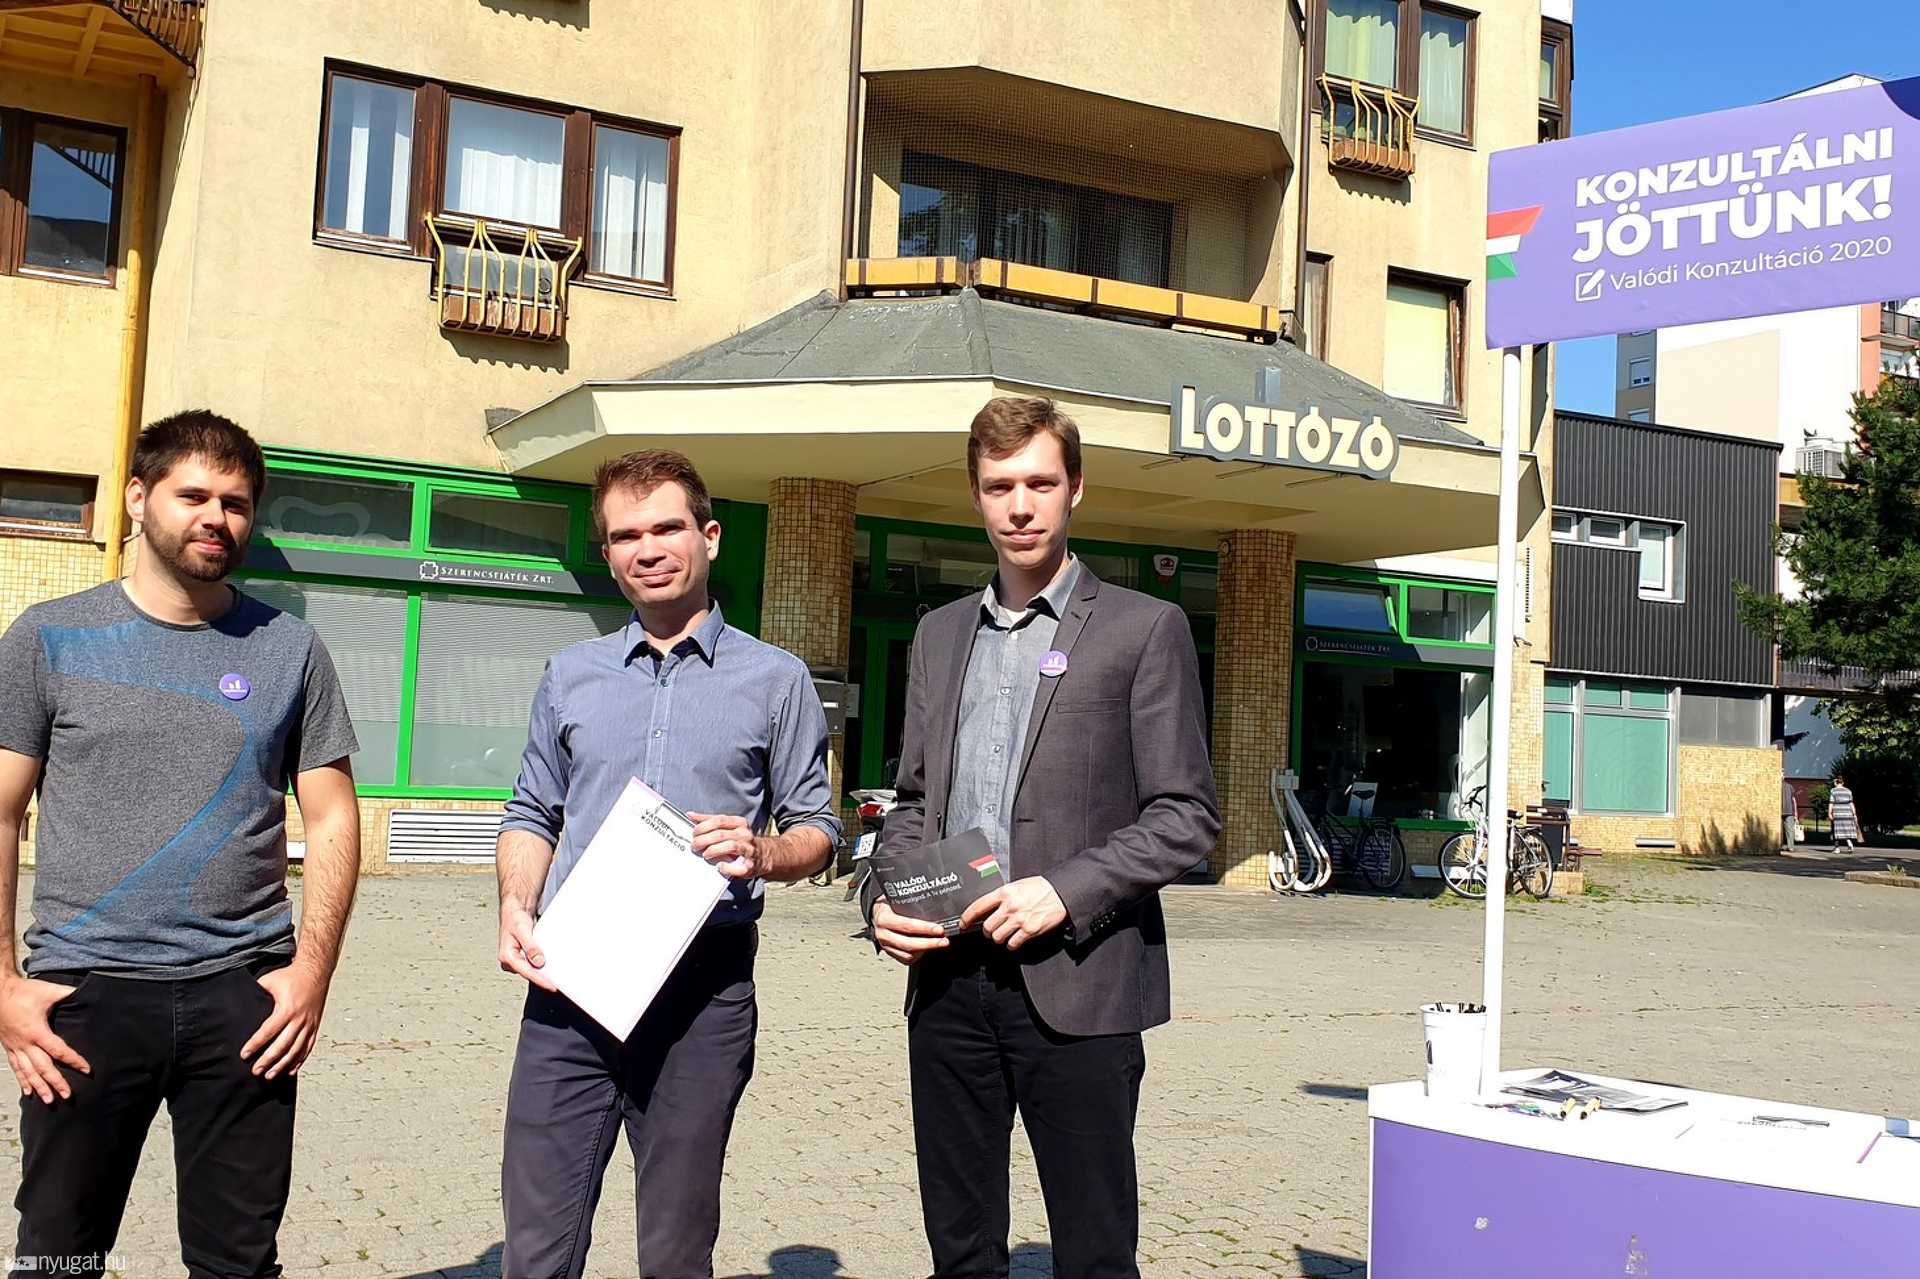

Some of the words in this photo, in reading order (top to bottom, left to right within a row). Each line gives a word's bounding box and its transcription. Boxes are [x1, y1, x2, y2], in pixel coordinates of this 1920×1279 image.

[1576, 128, 1894, 207] KONZULTÁLNI
[1572, 174, 1892, 263] JÖTTÜNK!
[1610, 264, 1678, 290] Valódi
[1685, 244, 1823, 281] Konzultáció
[1830, 236, 1892, 262] 2020
[1180, 387, 1394, 472] LOTTÓZÓ
[441, 566, 529, 582] SZERENCSEJÁTÉK
[533, 574, 554, 584] ZRT.
[893, 875, 927, 889] VALÓDI
[897, 872, 958, 896] KONZULTÁCIÓ
